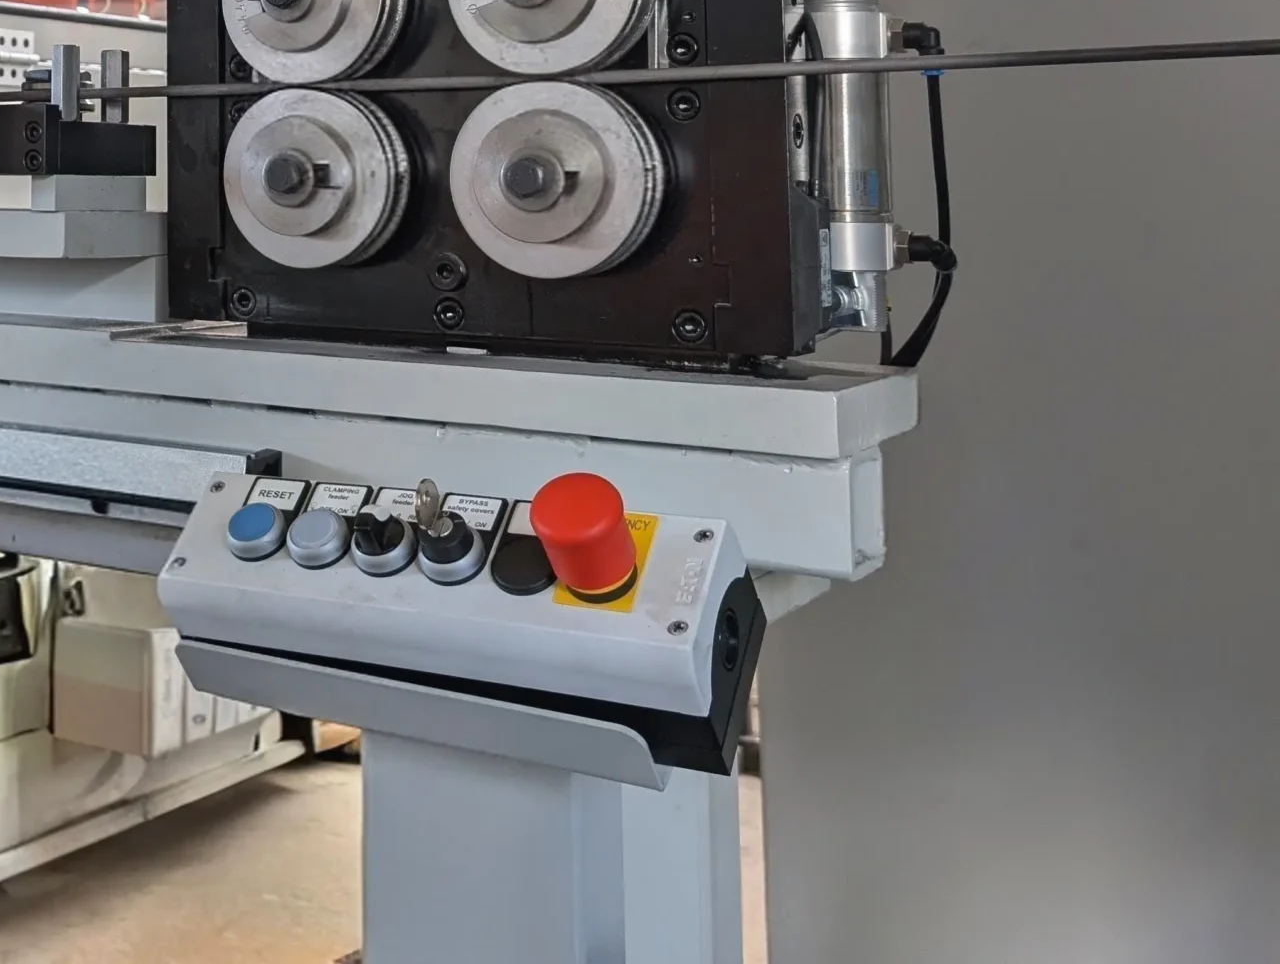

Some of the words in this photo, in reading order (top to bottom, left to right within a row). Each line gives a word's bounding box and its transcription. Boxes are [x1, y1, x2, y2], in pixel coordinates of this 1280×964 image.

[323, 486, 360, 494] CLAMPING
[258, 489, 295, 500] RESET
[327, 493, 350, 501] feeder
[392, 498, 414, 506] feeder
[459, 498, 489, 507] BYPASS
[625, 518, 651, 532] NCY
